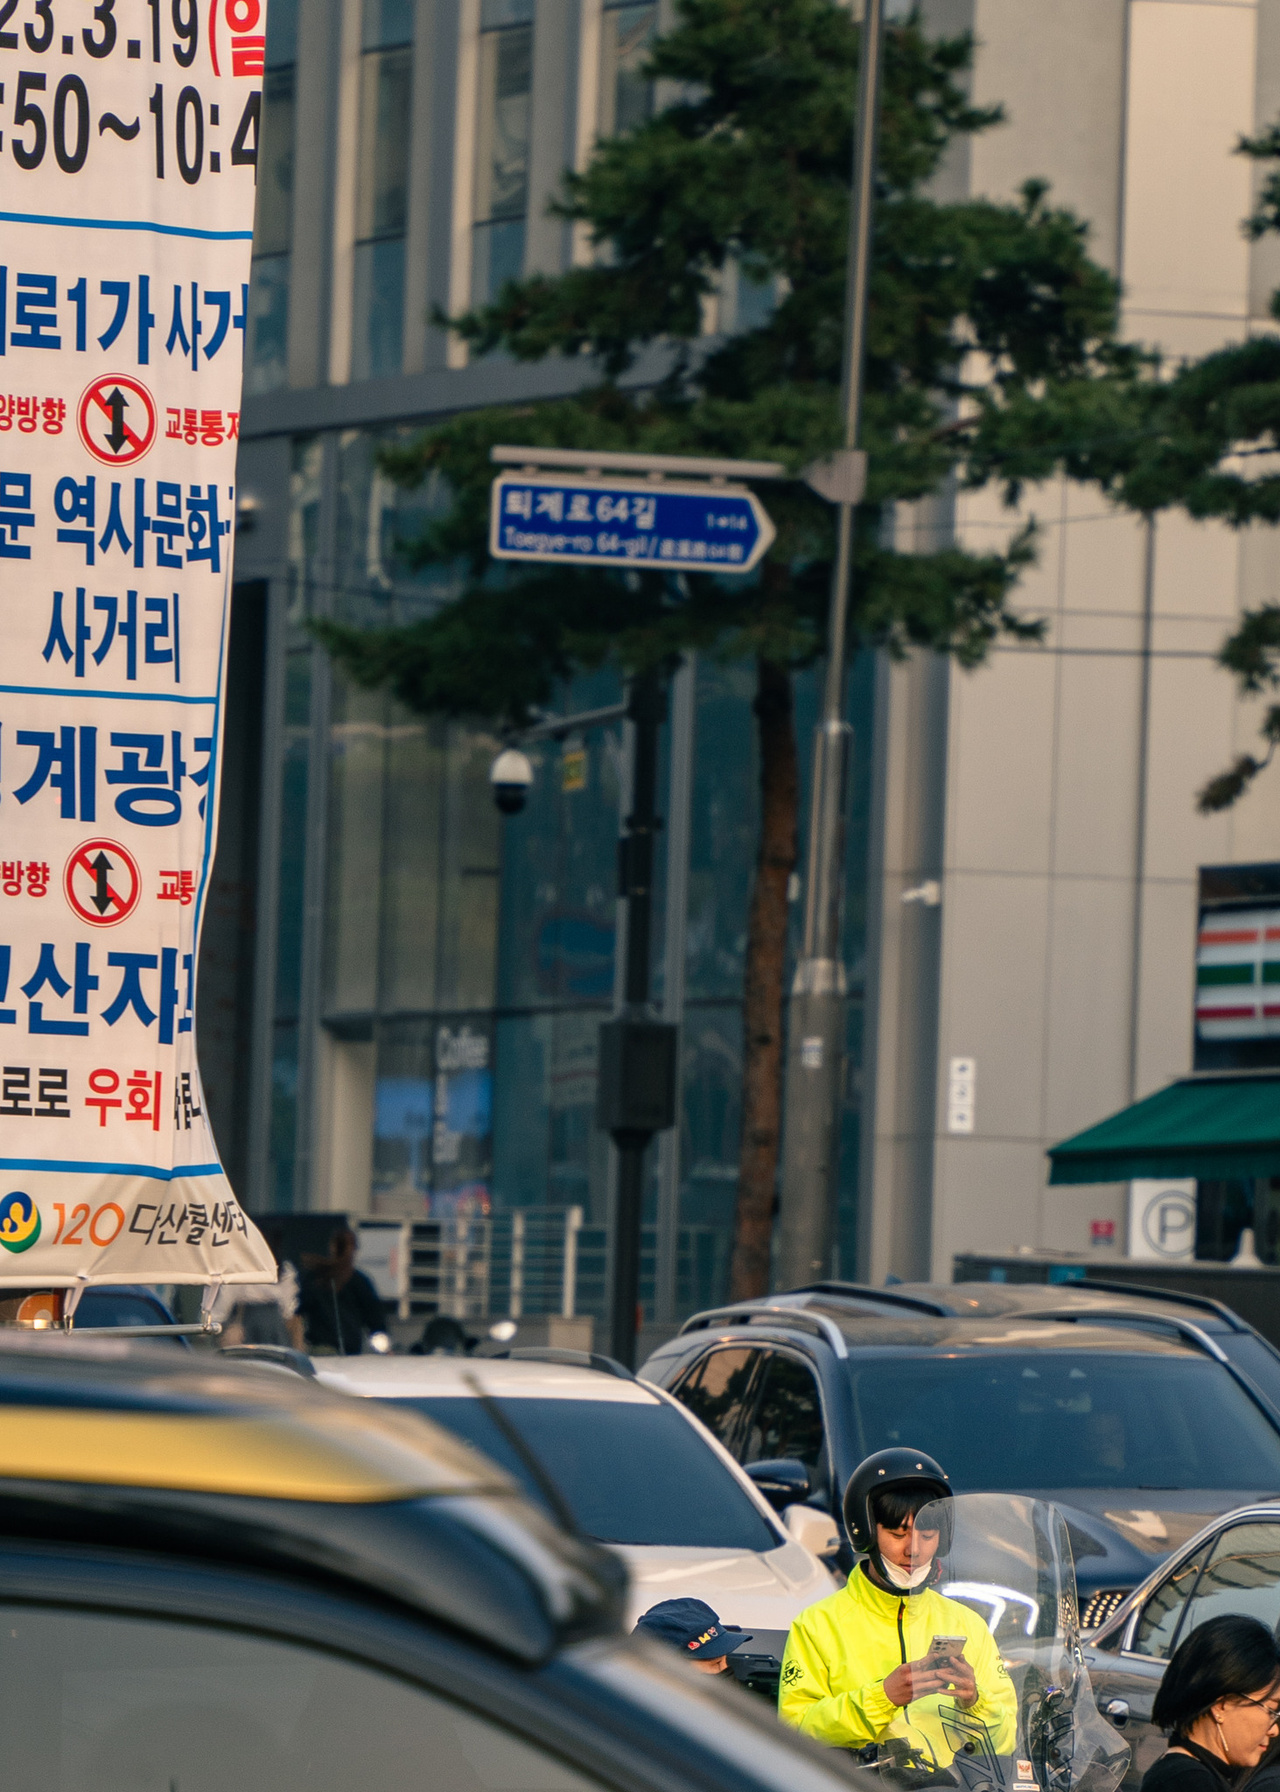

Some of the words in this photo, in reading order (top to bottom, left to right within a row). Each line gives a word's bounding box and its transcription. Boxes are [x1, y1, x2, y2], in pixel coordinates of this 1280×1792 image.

[54, 475, 233, 573] 역사문화
[42, 586, 181, 684] 사거리
[0, 722, 213, 827] 계광
[0, 860, 50, 898] 방향
[85, 1068, 162, 1131] 우회
